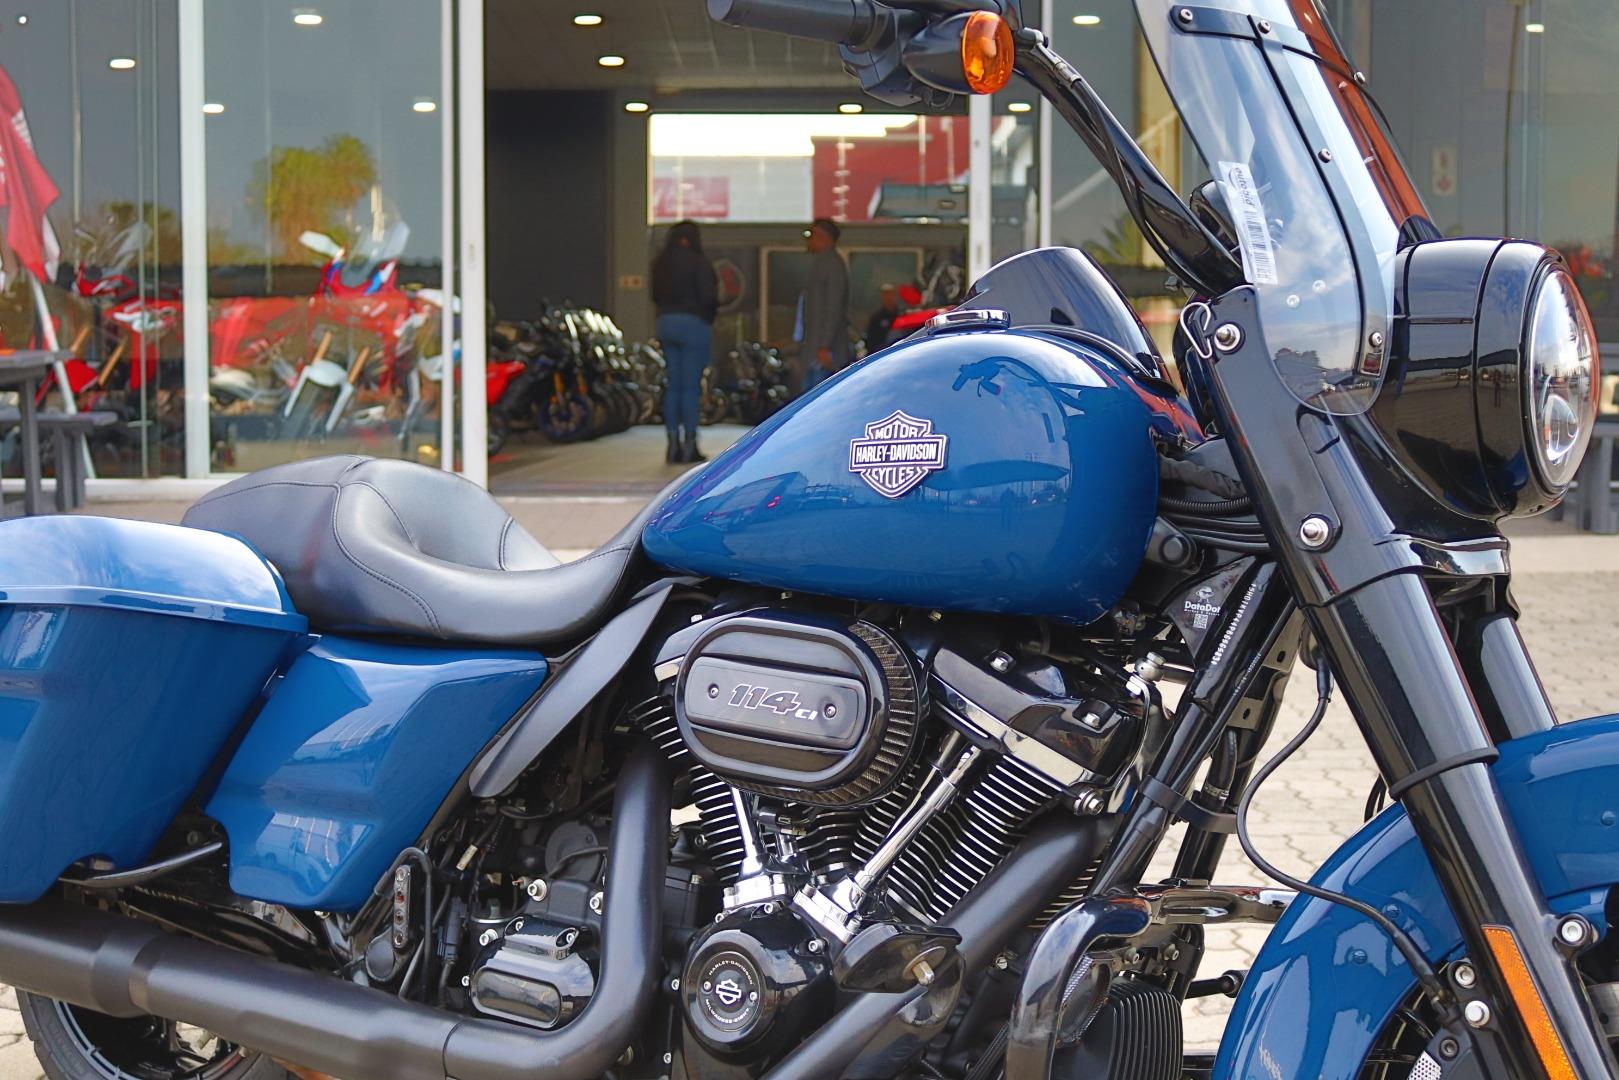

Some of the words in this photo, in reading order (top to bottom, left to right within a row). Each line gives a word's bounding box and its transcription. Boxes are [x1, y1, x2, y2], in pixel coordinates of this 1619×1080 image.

[874, 419, 919, 440] MOTOR
[855, 443, 938, 463] HARLEY-DAVIDSON
[871, 466, 915, 489] CYCLES
[1184, 601, 1221, 614] DataDot
[728, 683, 801, 714] 114
